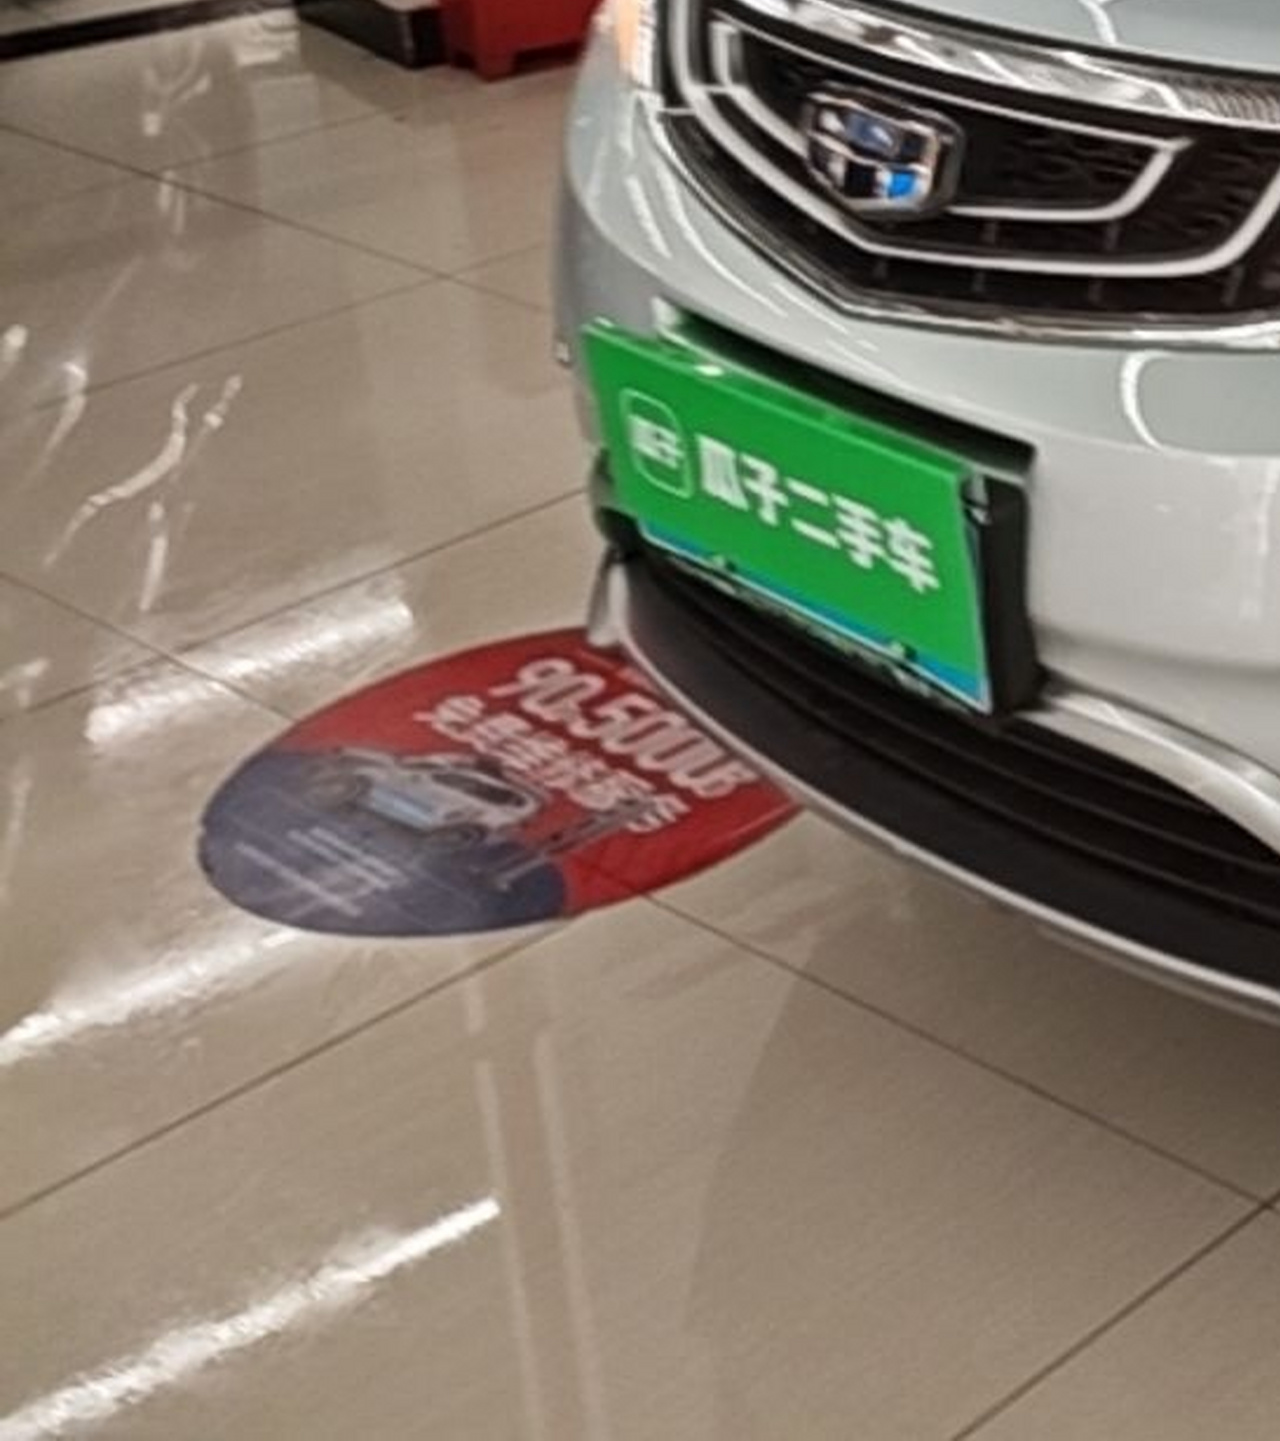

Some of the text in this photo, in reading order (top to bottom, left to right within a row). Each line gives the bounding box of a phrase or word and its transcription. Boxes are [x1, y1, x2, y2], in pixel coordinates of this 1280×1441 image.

[695, 431, 940, 594] 瓜子二手车
